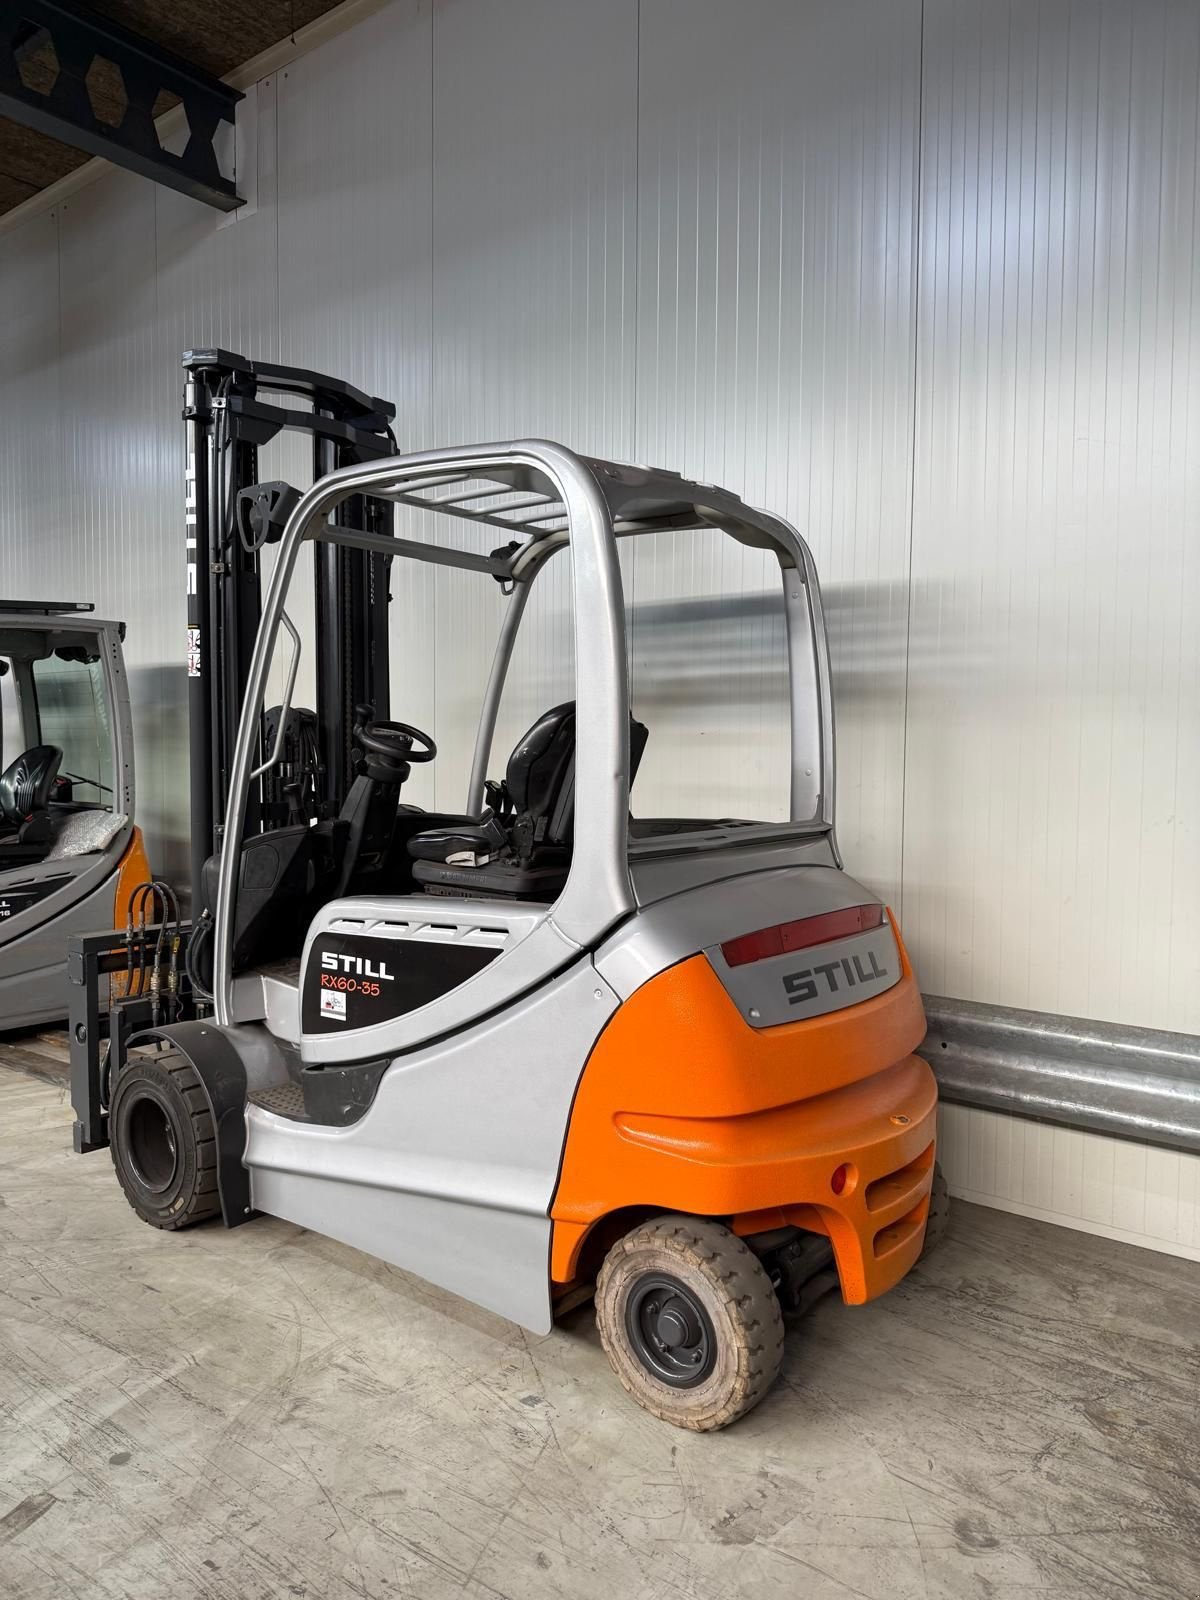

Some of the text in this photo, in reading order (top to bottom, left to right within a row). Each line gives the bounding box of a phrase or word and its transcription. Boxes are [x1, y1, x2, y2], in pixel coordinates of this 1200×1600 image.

[321, 951, 395, 981] STILL
[782, 951, 888, 1005] STILL
[320, 974, 381, 997] RX60-35
